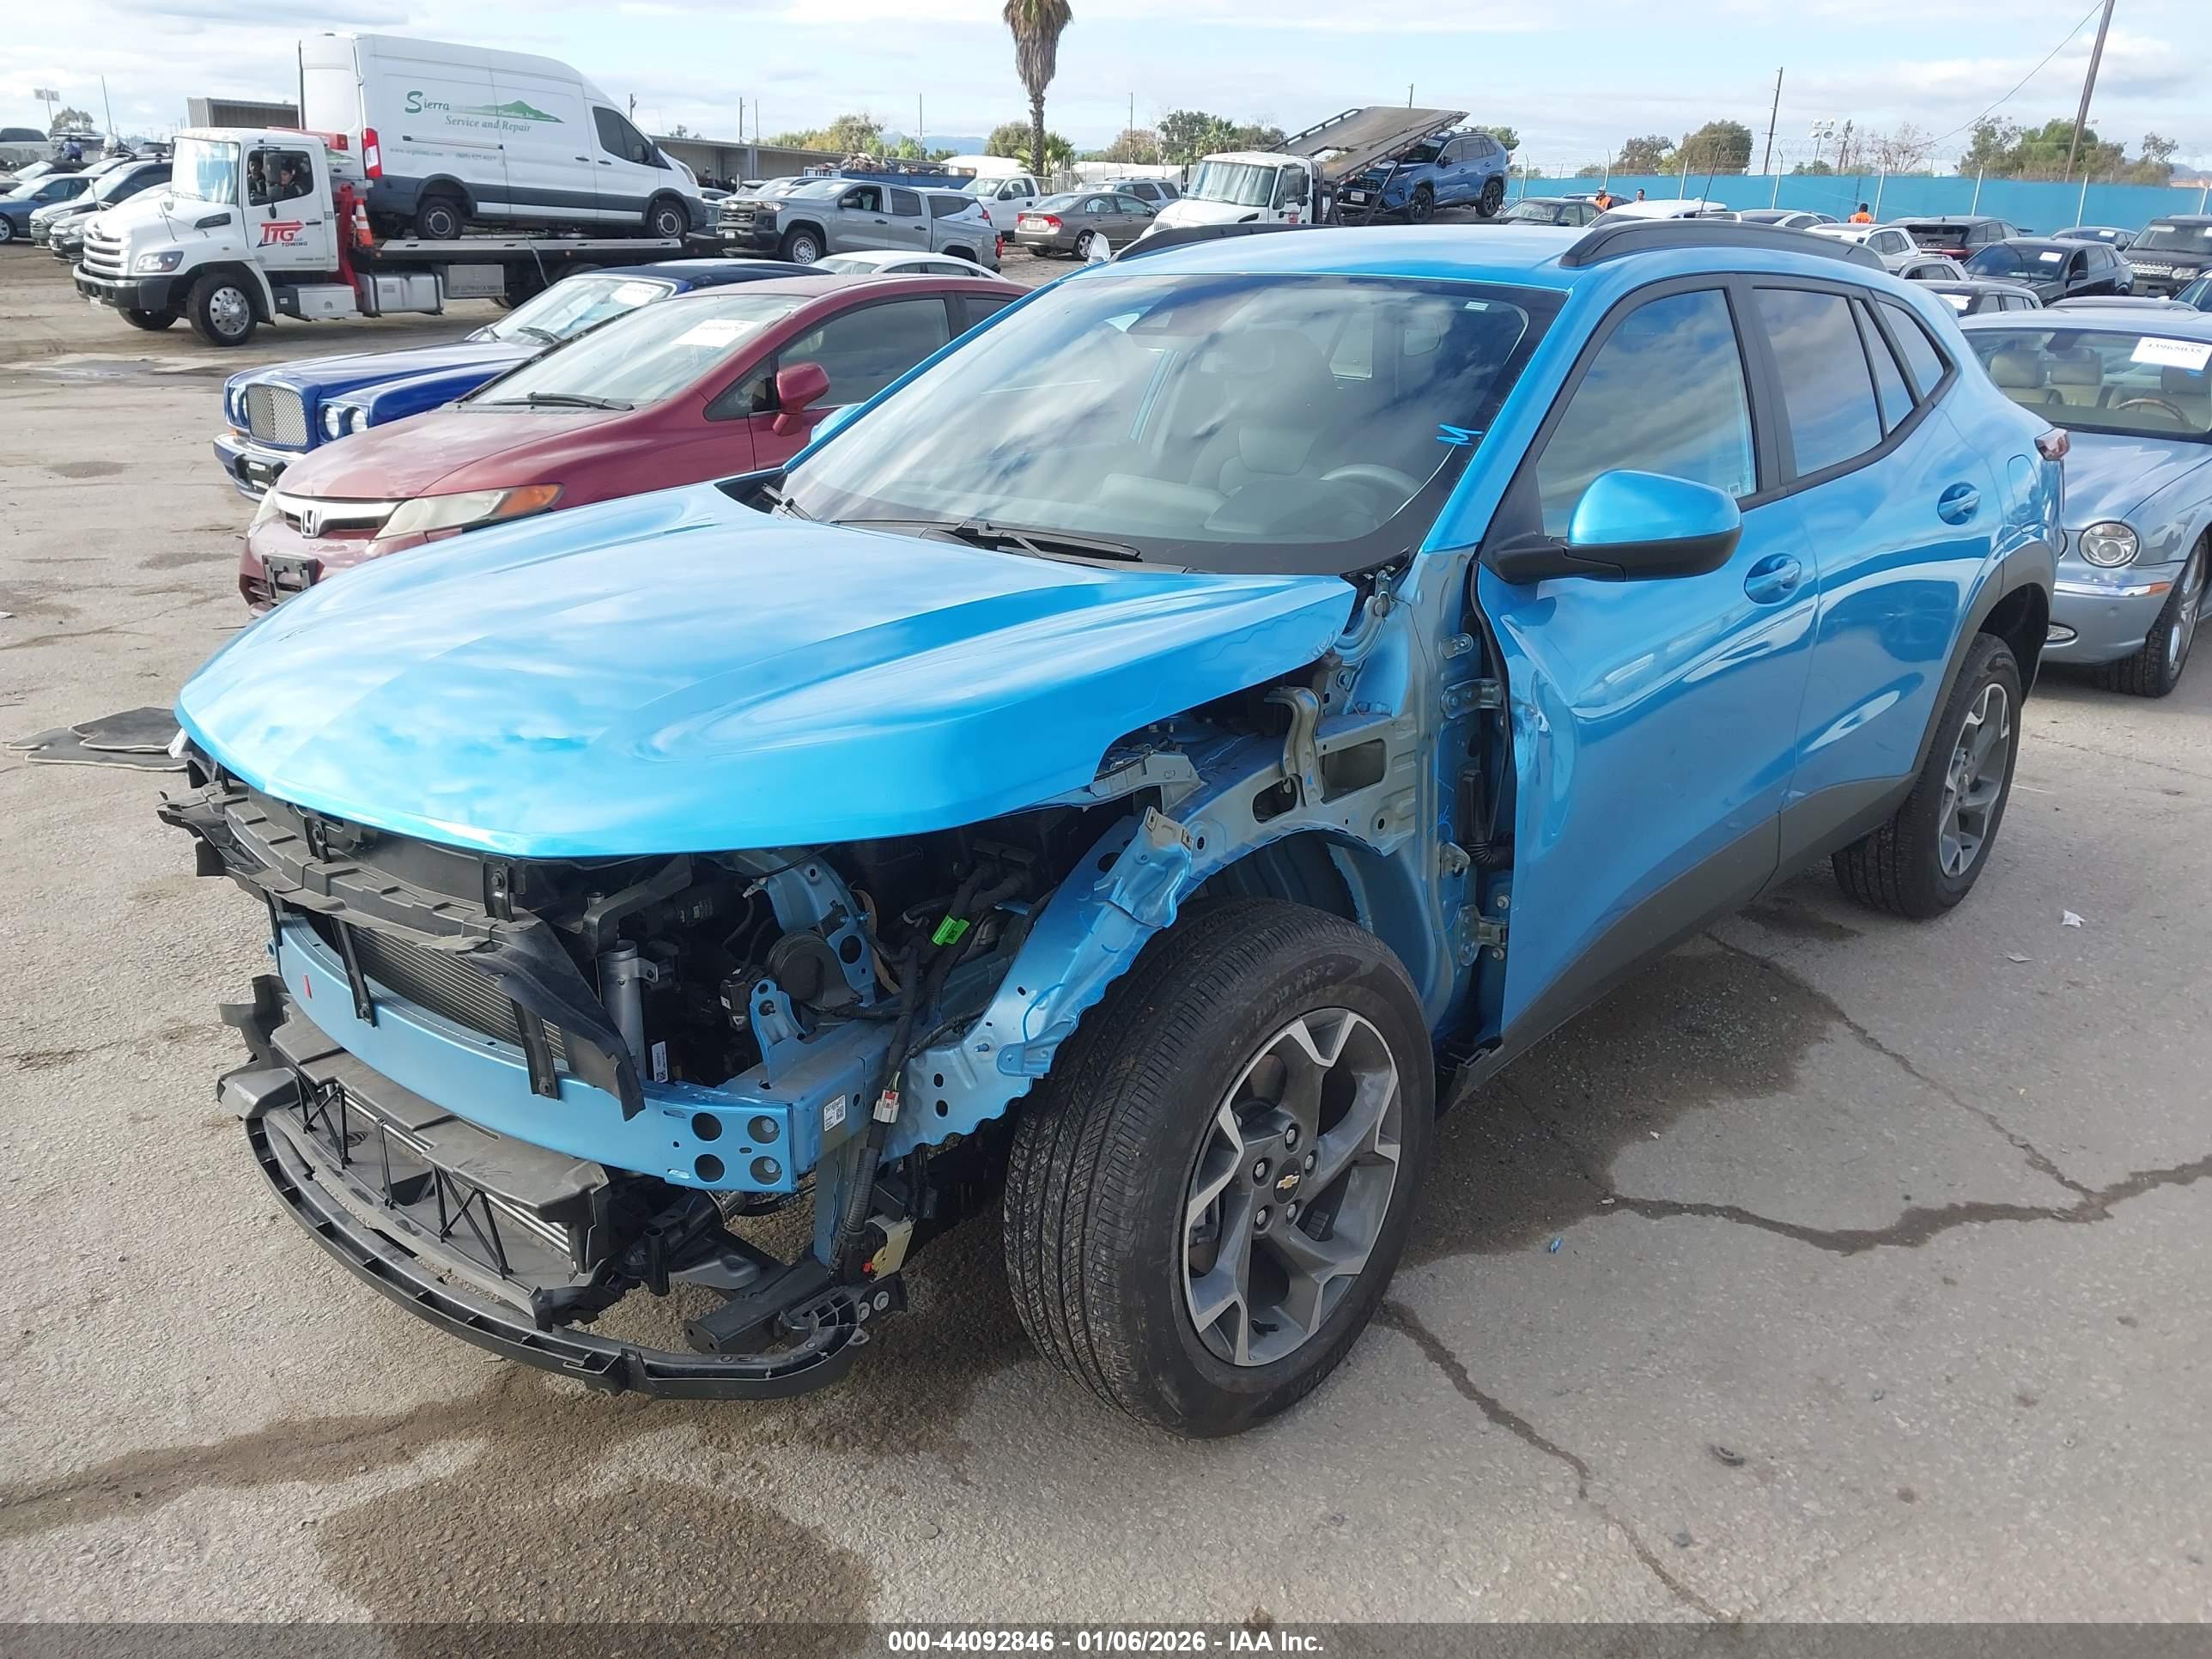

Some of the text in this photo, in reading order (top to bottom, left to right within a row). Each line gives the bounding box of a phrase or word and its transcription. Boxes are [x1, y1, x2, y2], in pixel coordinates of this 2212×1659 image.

[404, 90, 450, 114] Sierra
[446, 115, 531, 134] Service and Repair
